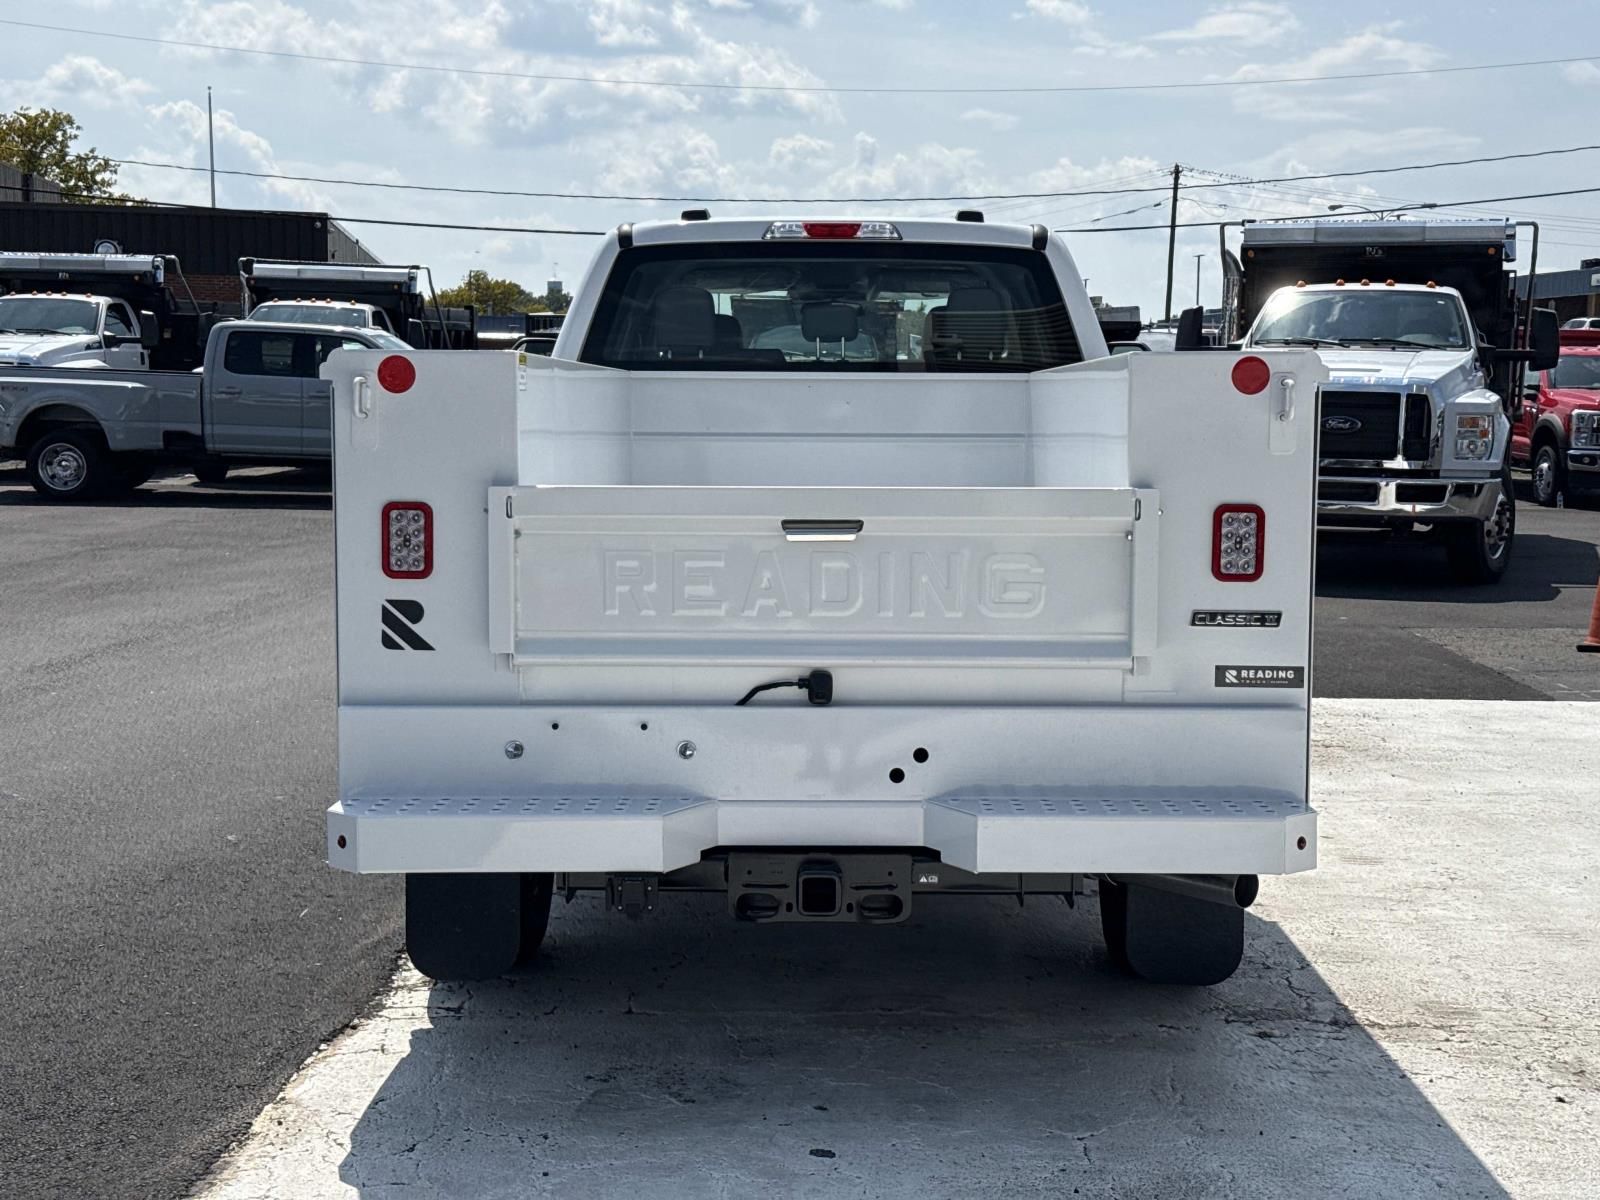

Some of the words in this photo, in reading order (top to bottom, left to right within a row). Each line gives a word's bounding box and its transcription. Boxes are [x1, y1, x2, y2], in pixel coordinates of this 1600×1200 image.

[1326, 418, 1351, 429] Ford
[603, 549, 1046, 618] READING
[1195, 613, 1261, 625] CLASSIC
[1241, 669, 1295, 679] READING
